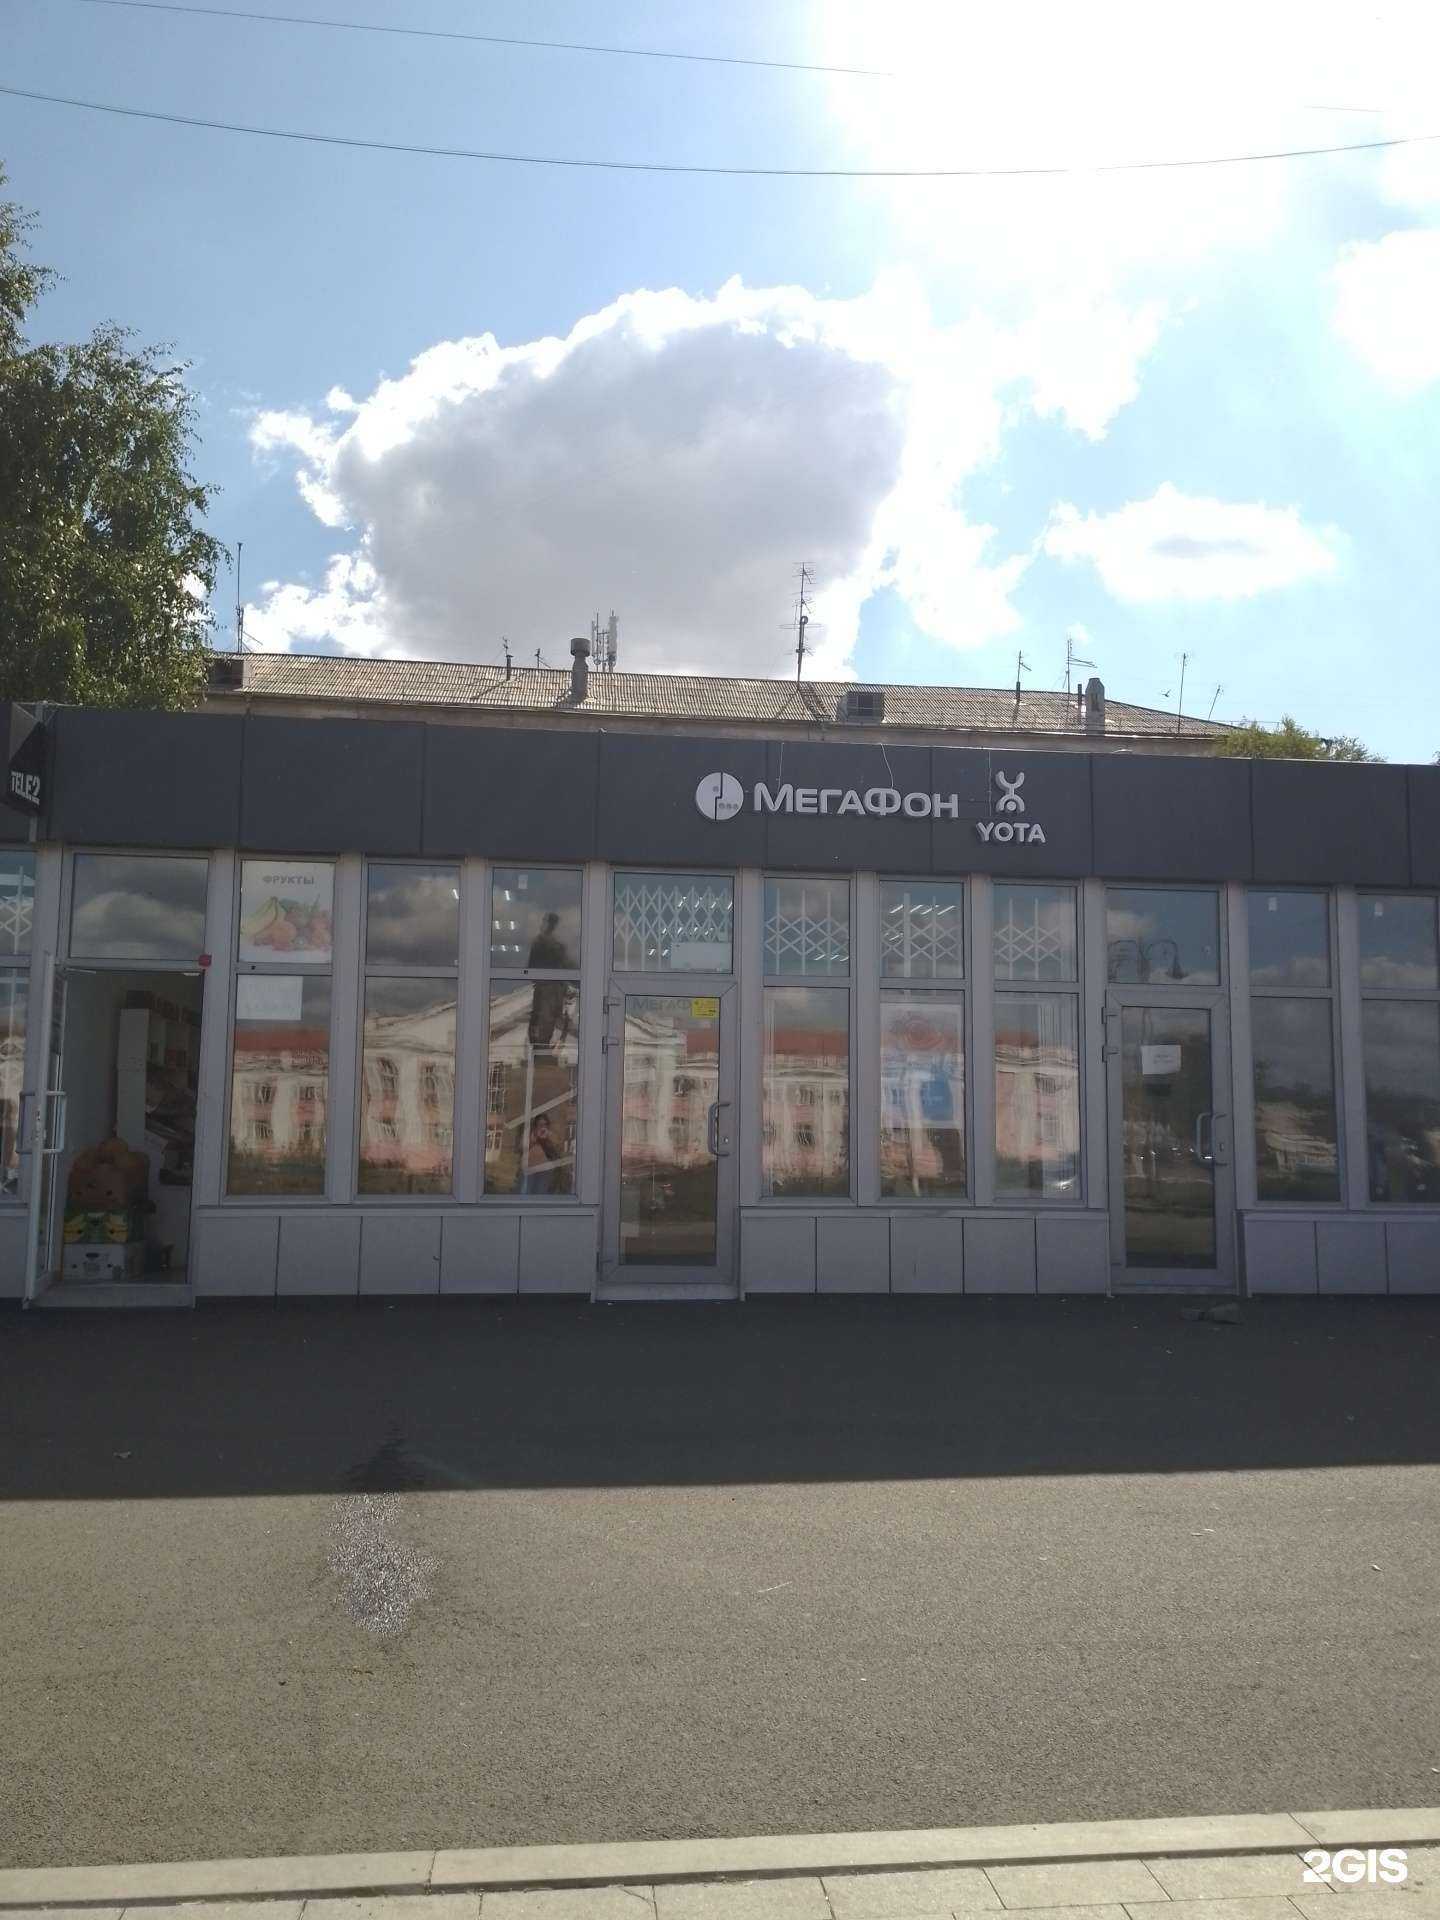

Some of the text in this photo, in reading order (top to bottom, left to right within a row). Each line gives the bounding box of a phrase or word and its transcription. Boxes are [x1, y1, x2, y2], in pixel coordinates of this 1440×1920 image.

[11, 771, 40, 805] TELE2
[753, 782, 959, 818] МЕГАФОН
[976, 822, 1046, 843] YOTA
[262, 875, 314, 885] ФРУКТЫ
